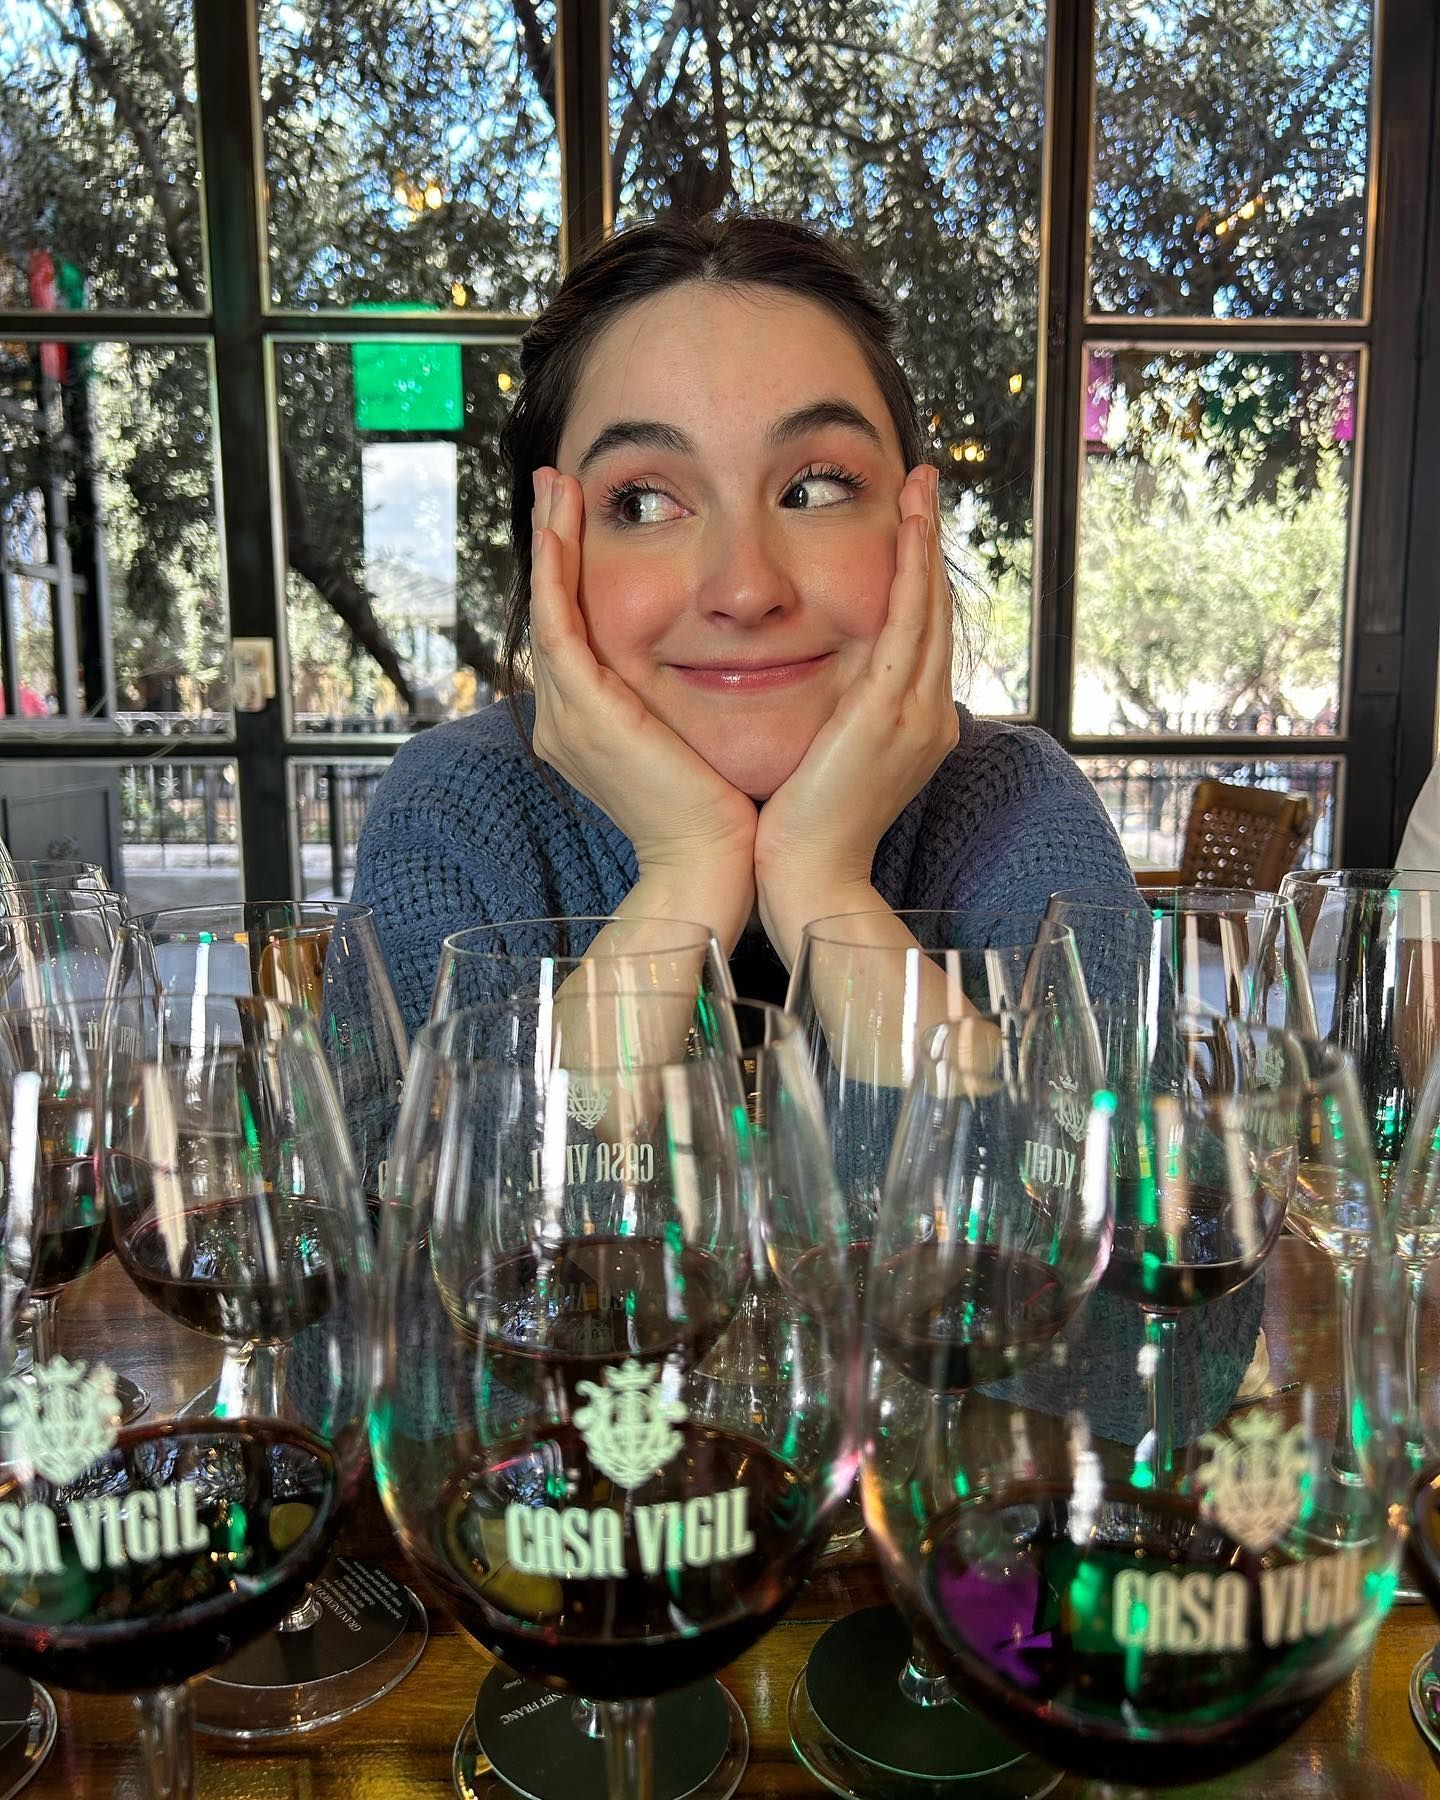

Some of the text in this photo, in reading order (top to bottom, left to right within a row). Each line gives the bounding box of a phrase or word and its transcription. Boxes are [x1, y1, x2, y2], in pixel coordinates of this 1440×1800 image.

[67, 1479, 210, 1573] VIGIL
[505, 1487, 755, 1579] CASA VIGIL
[1113, 1568, 1248, 1653] CASA
[500, 1703, 540, 1724] FRANC
